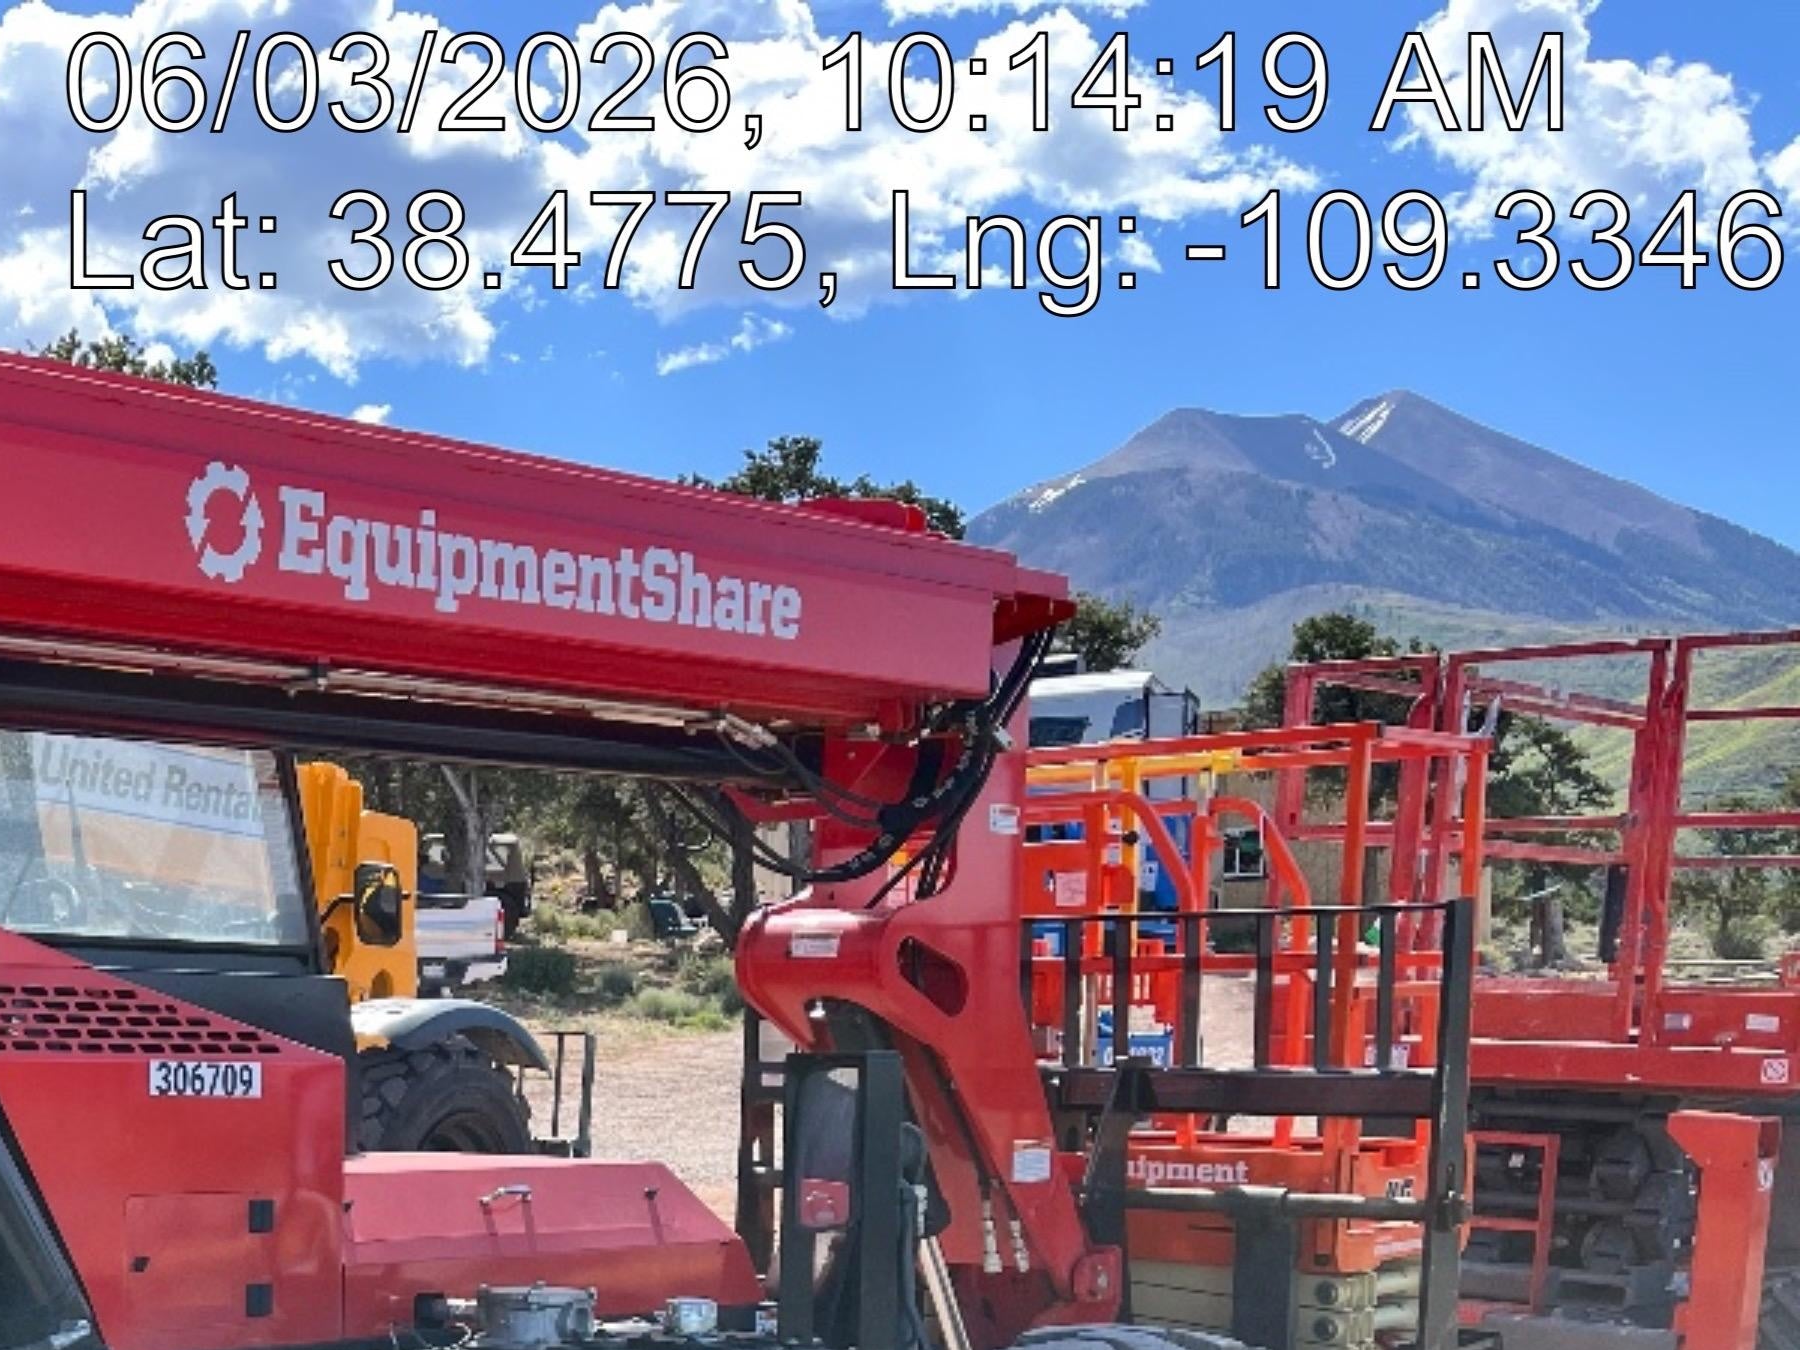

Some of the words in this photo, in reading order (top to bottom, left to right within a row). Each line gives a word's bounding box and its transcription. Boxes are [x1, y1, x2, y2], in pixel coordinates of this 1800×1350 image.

[278, 485, 802, 640] EquipmentShare
[39, 738, 155, 802] United
[155, 1062, 253, 1096] 306709
